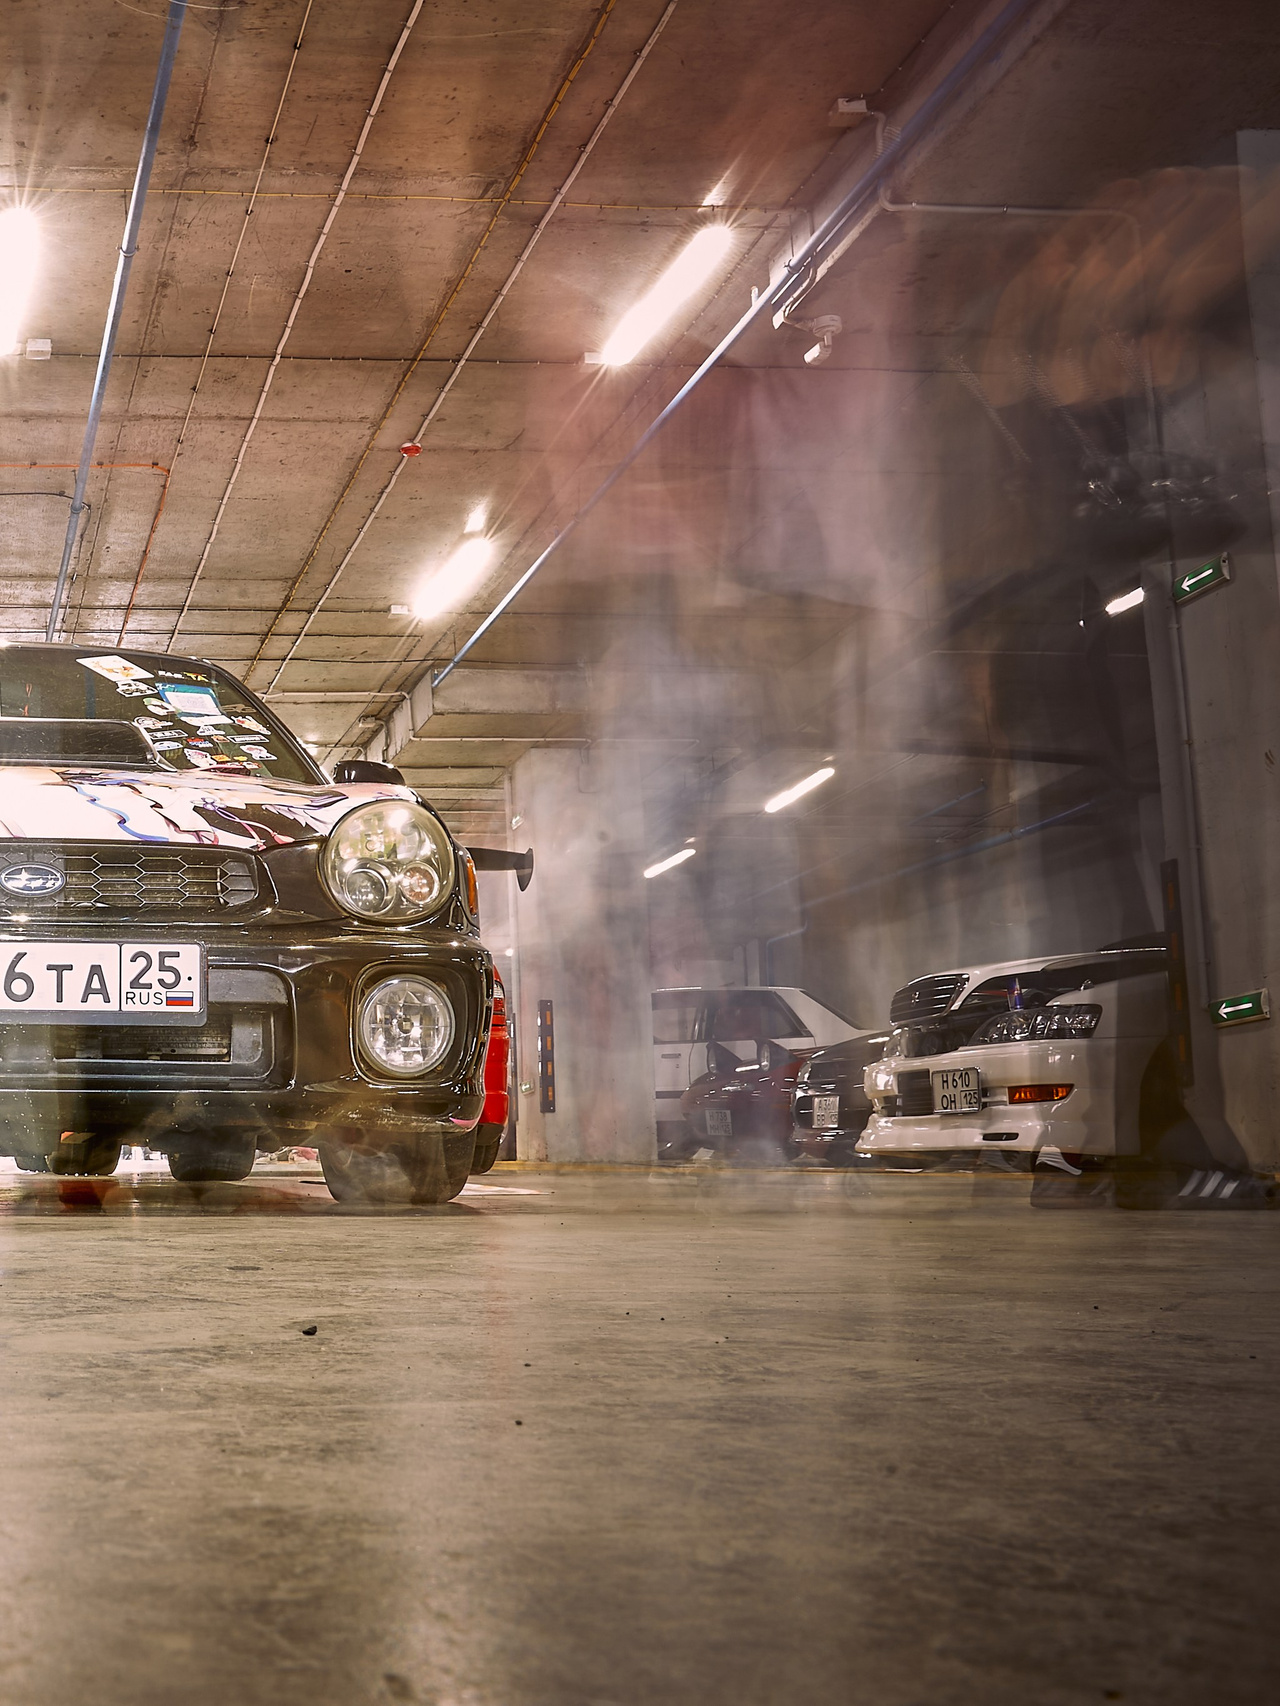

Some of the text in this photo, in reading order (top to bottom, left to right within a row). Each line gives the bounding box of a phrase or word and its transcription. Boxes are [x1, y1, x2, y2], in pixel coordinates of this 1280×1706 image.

[130, 951, 181, 989] 25
[125, 991, 163, 1005] RUS
[963, 1091, 978, 1105] 125
